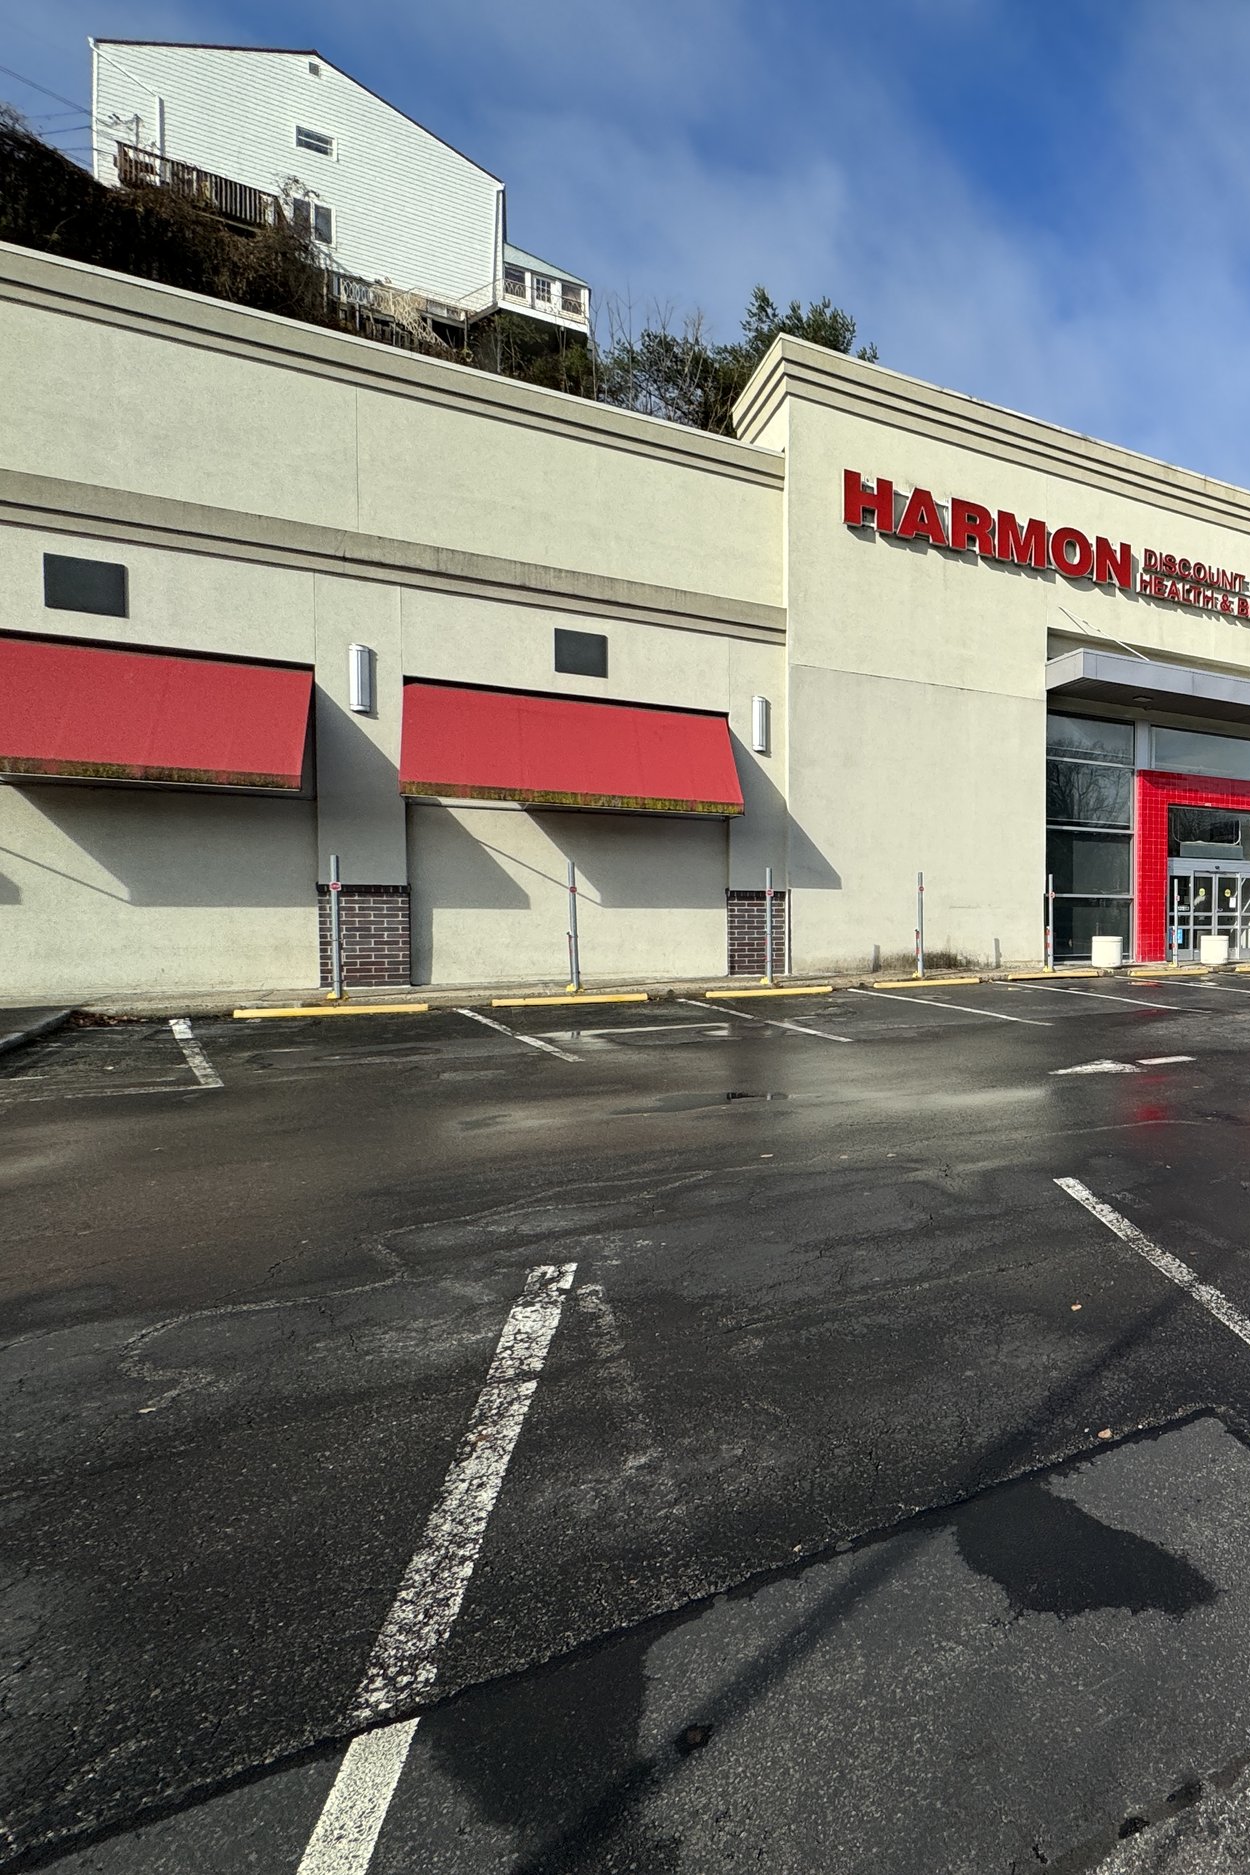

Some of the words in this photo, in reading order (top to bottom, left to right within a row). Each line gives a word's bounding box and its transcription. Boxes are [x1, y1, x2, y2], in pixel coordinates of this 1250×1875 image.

[843, 468, 1133, 590] HARMON
[1138, 572, 1216, 609] HEALTH
[1219, 592, 1233, 613] &
[1143, 548, 1246, 593] DISCOUNT
